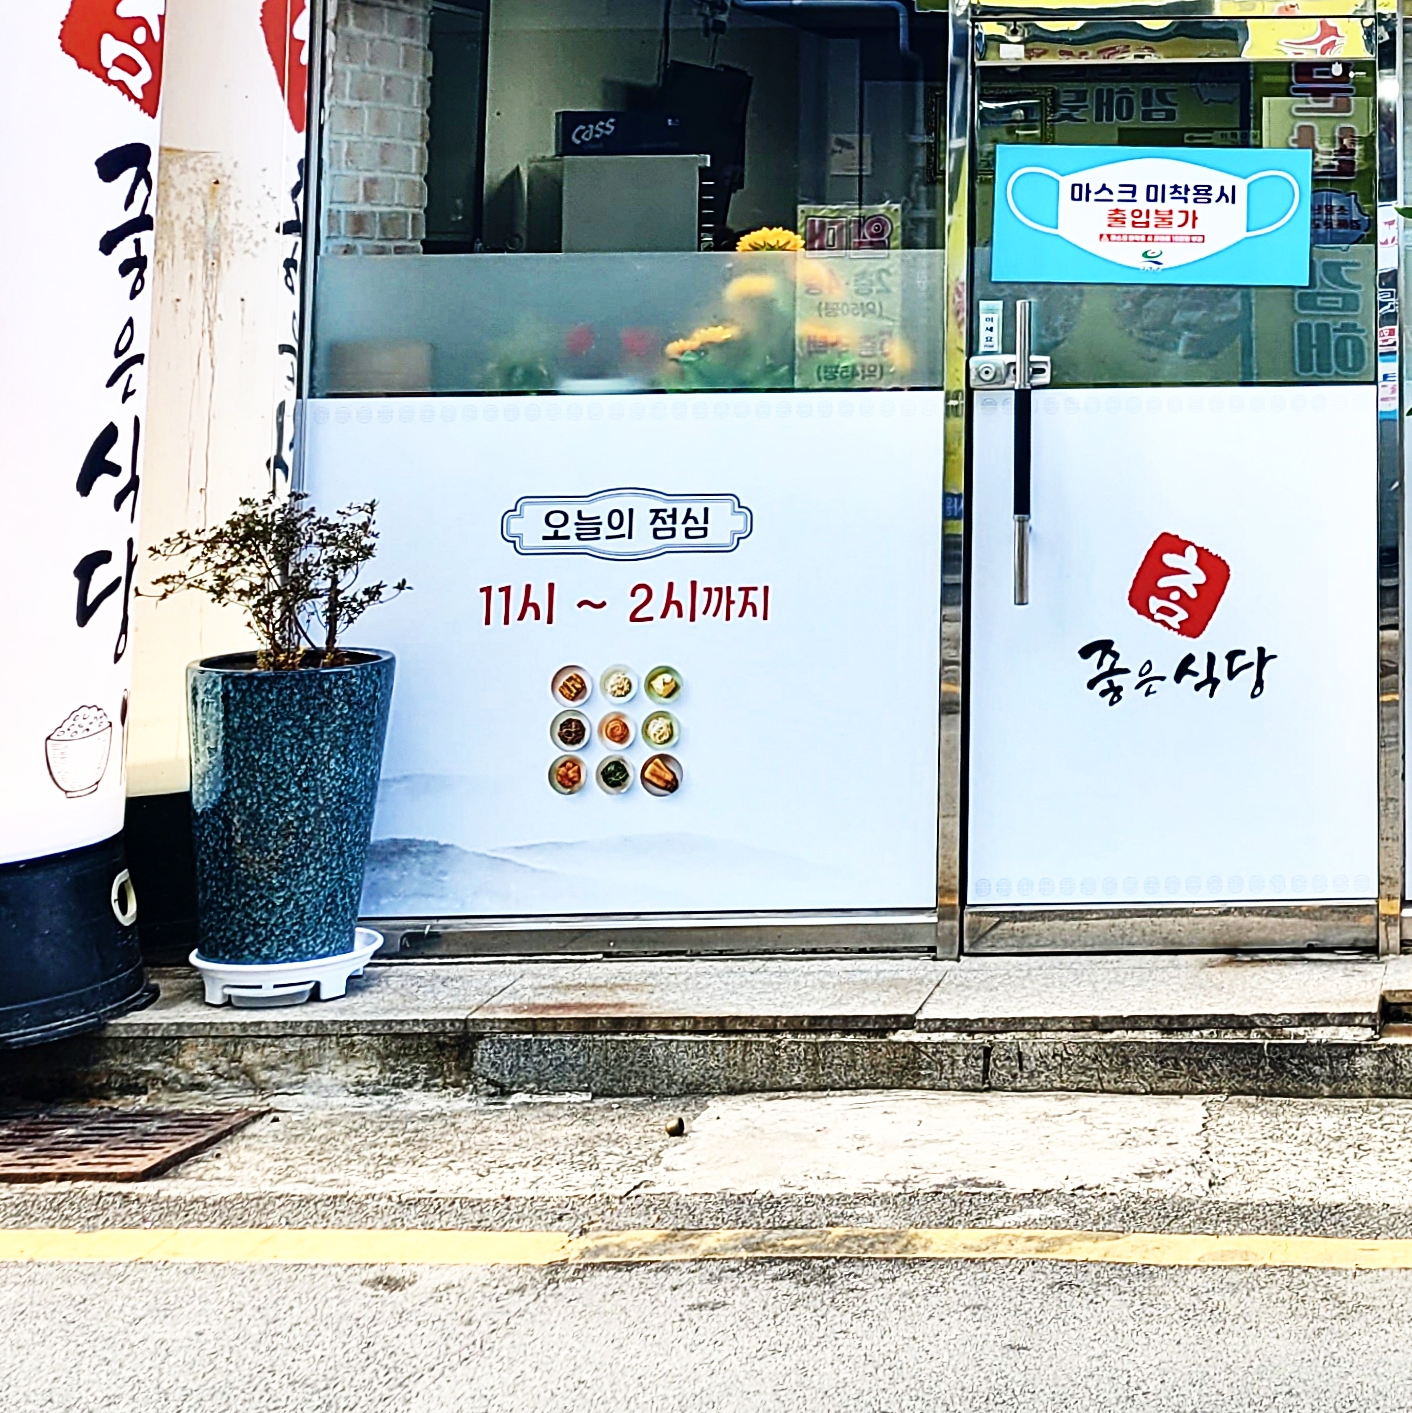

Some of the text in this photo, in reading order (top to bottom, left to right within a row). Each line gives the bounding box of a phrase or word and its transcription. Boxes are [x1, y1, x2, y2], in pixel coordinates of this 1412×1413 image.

[1070, 182, 1237, 205] 마스크 미착용시
[1107, 207, 1199, 230] 출입불가
[73, 142, 154, 665] 좋은식당
[541, 506, 710, 541] 오늘의 점심
[479, 582, 555, 626] 11시
[628, 579, 770, 623] 2시까지
[1078, 638, 1279, 707] 좋은식당
